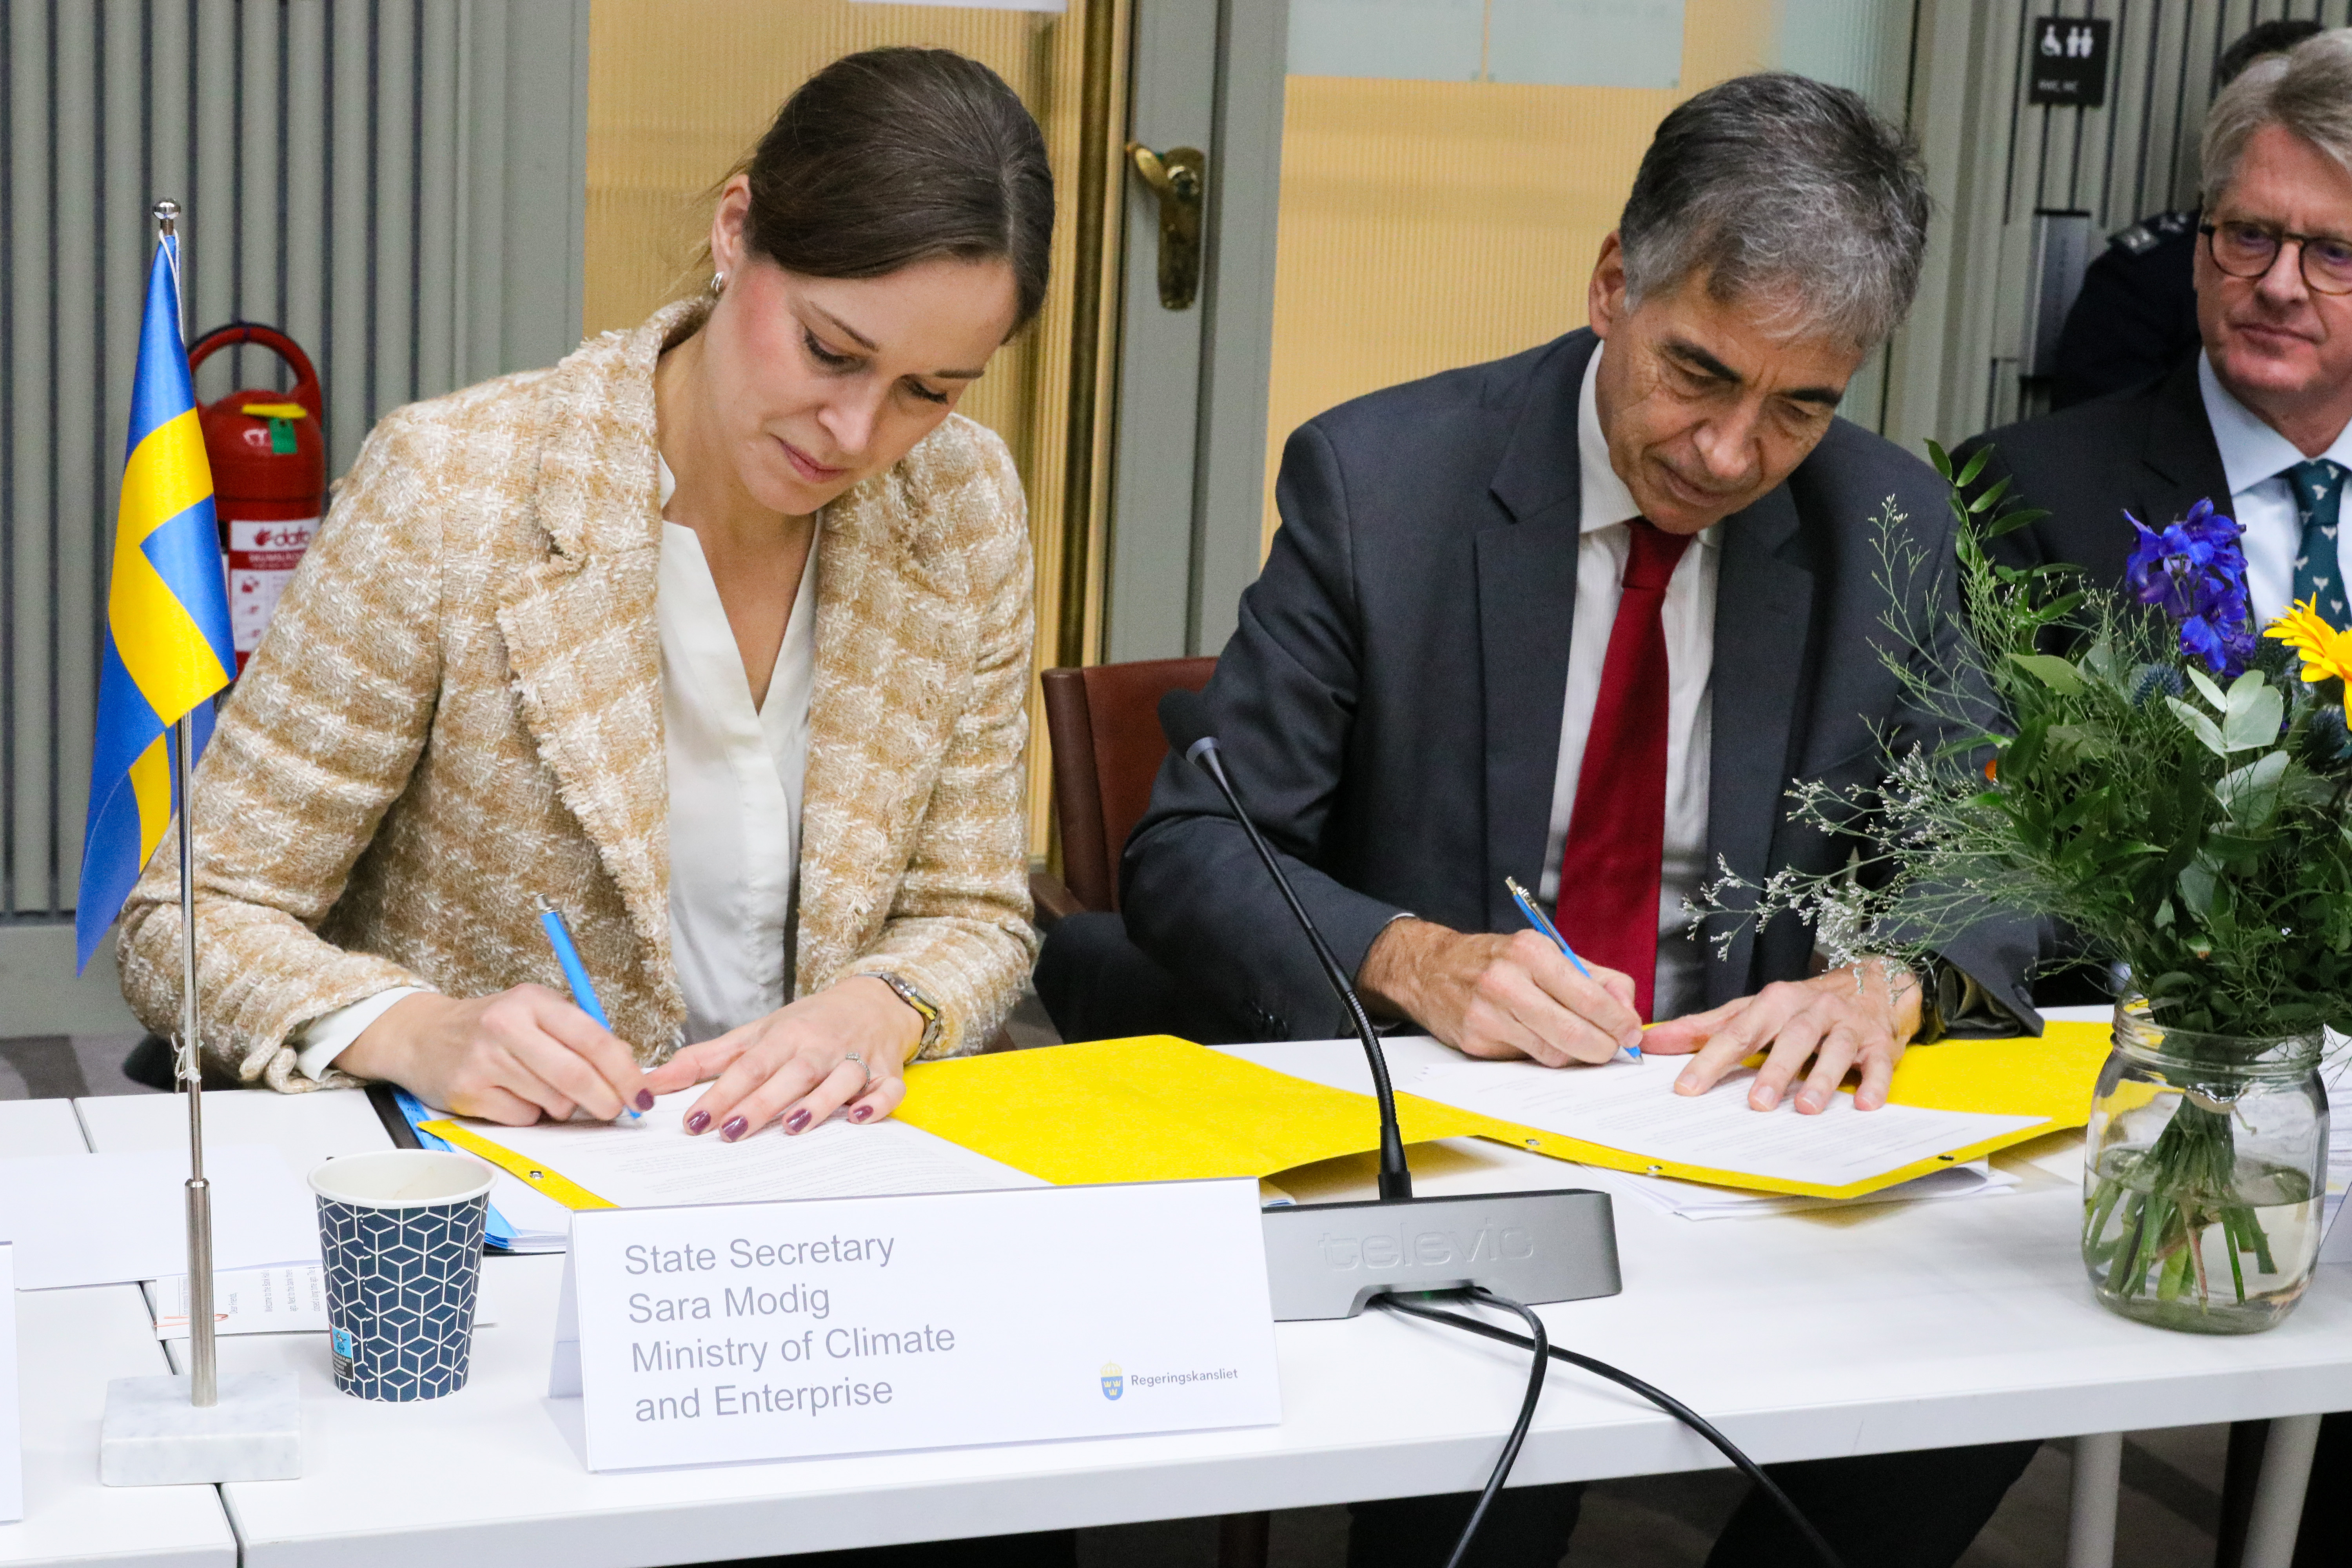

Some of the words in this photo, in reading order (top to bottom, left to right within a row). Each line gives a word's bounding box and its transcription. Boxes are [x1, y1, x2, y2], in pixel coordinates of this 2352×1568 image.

[626, 1244, 715, 1274] State
[730, 1235, 894, 1268] Secretary
[1318, 1217, 1534, 1270] televic
[630, 1293, 711, 1323] Sara
[725, 1283, 829, 1319] Modig
[633, 1338, 768, 1372] Ministry
[782, 1330, 813, 1361] of
[826, 1324, 955, 1358] Climate
[636, 1388, 700, 1421] and
[715, 1377, 892, 1416] Enterprise
[1131, 1368, 1238, 1388] Regeringskansliet
